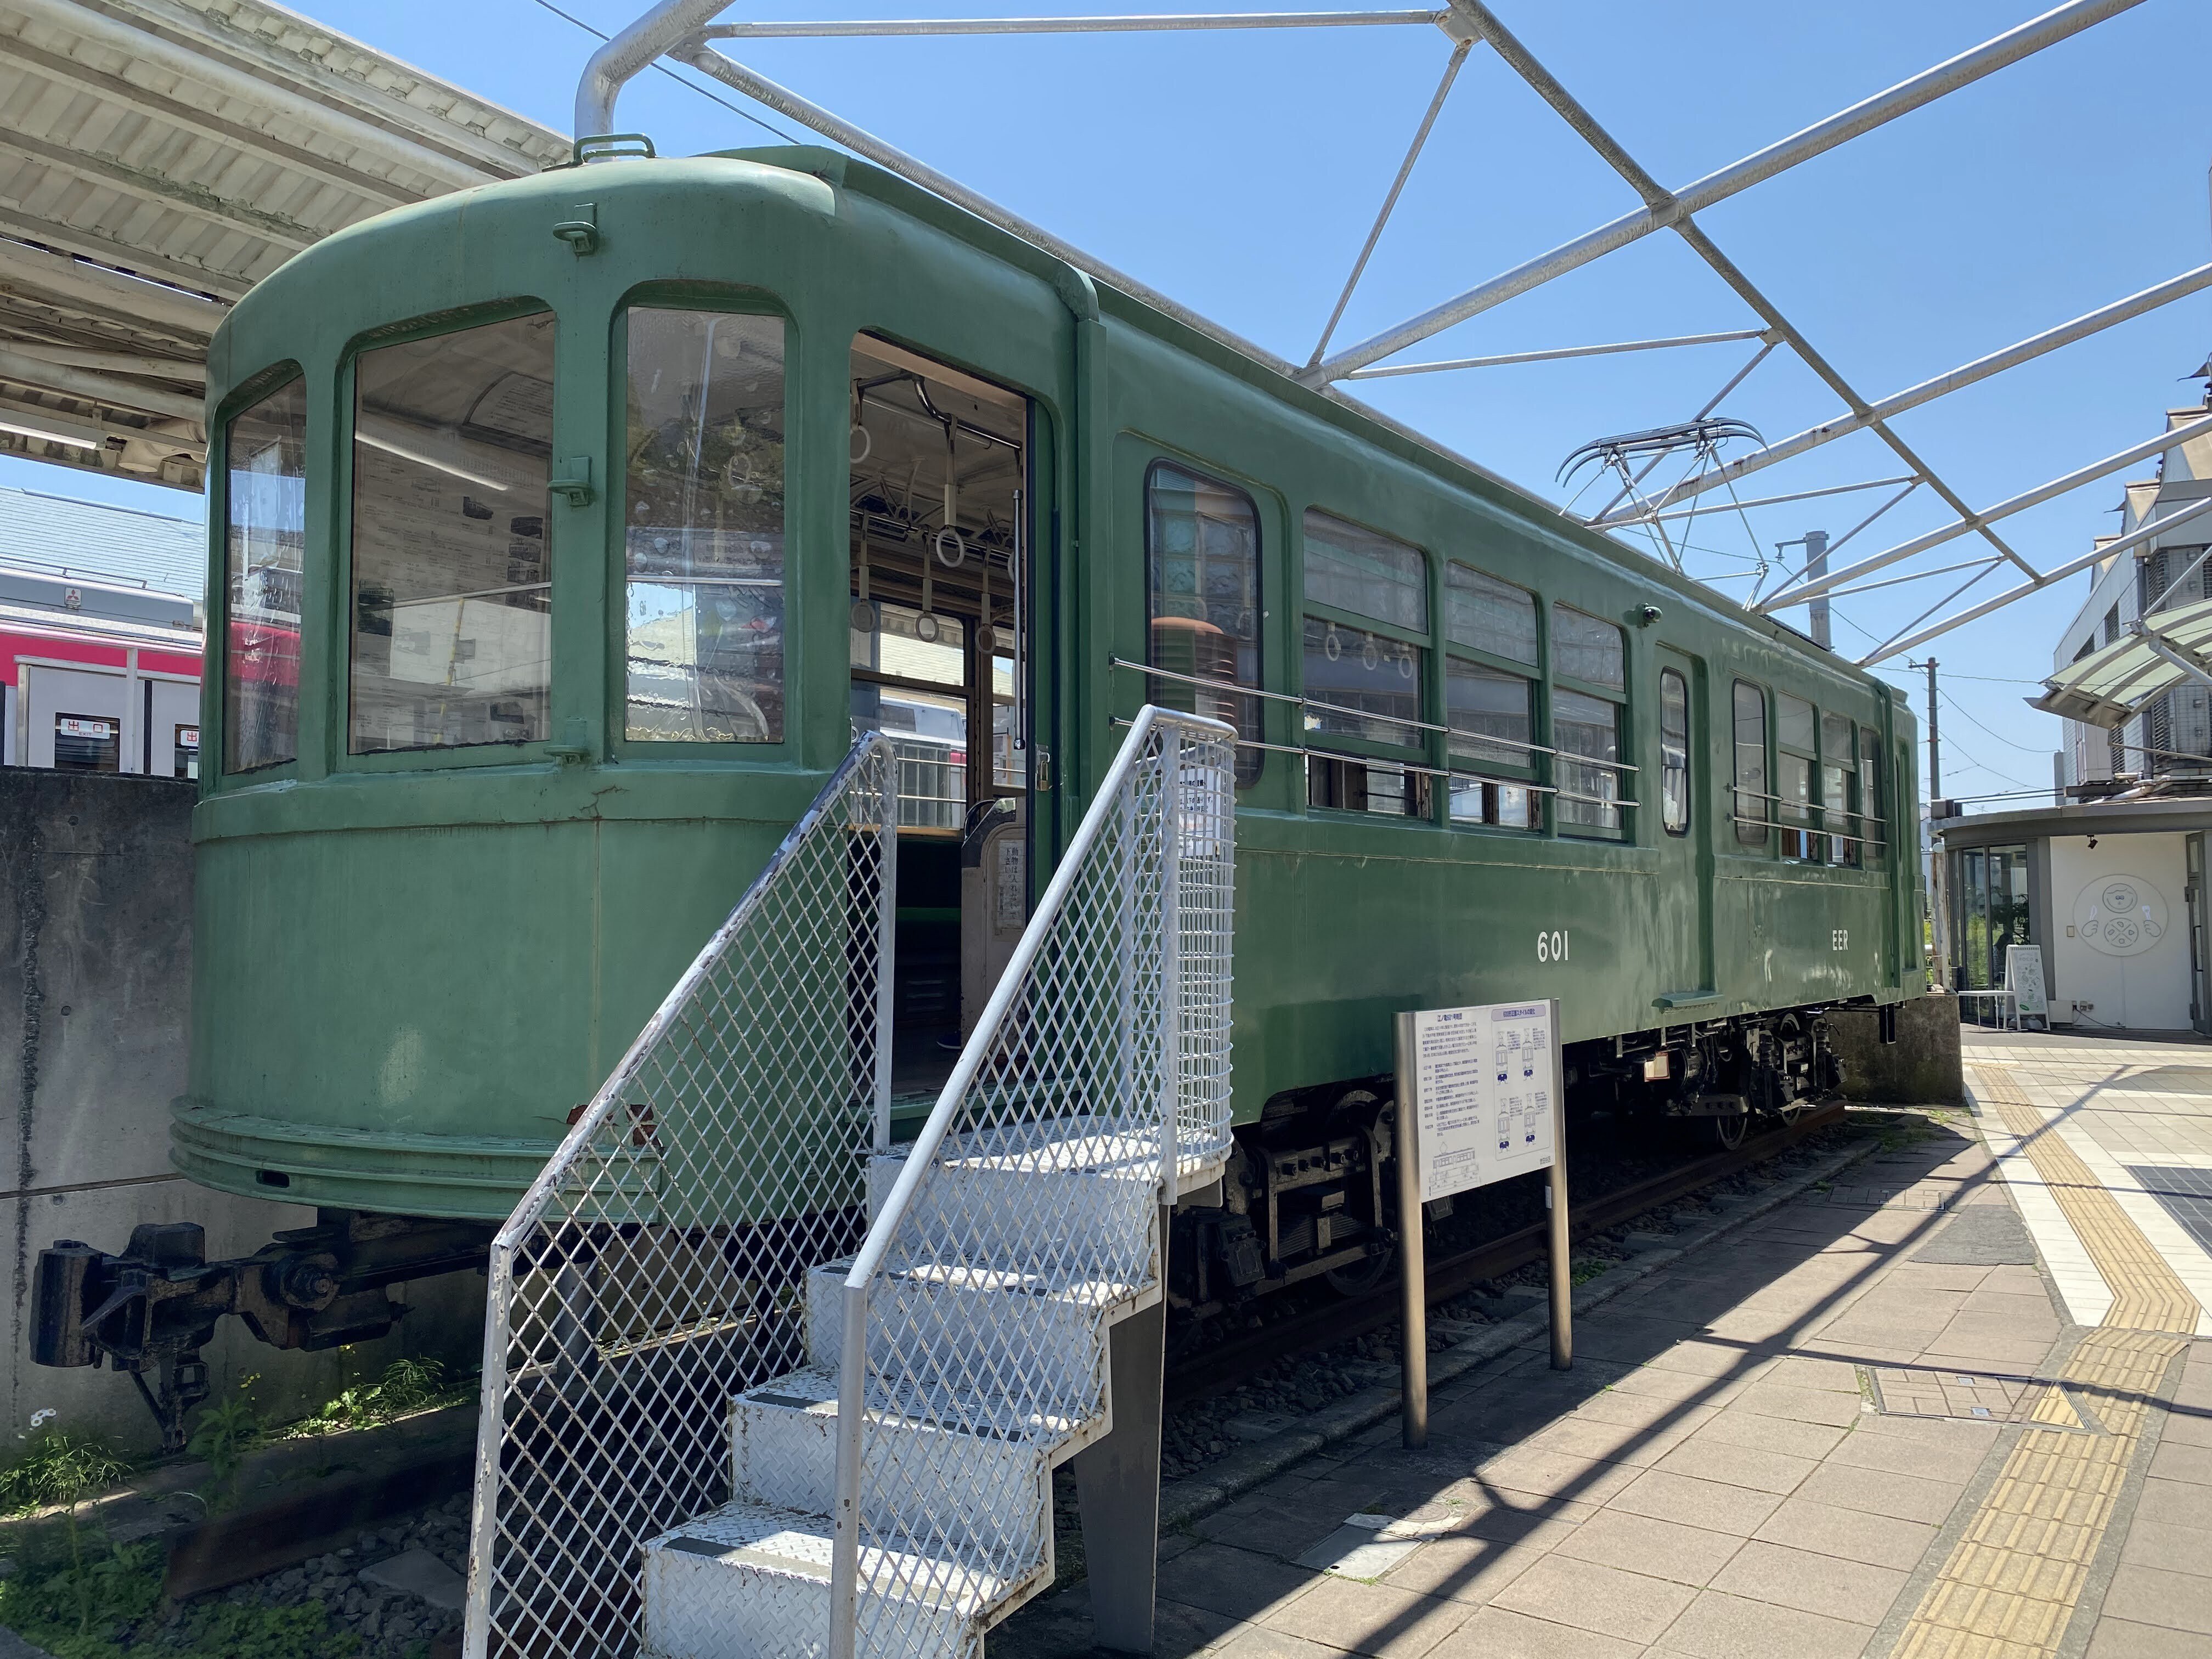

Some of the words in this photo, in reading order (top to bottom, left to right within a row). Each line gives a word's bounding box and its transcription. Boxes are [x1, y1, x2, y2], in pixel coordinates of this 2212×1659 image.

[187, 731, 197, 742] 出
[1010, 847, 1019, 919] 動物は入れないで
[1537, 930, 1568, 962] 601
[1832, 929, 1848, 951] EER
